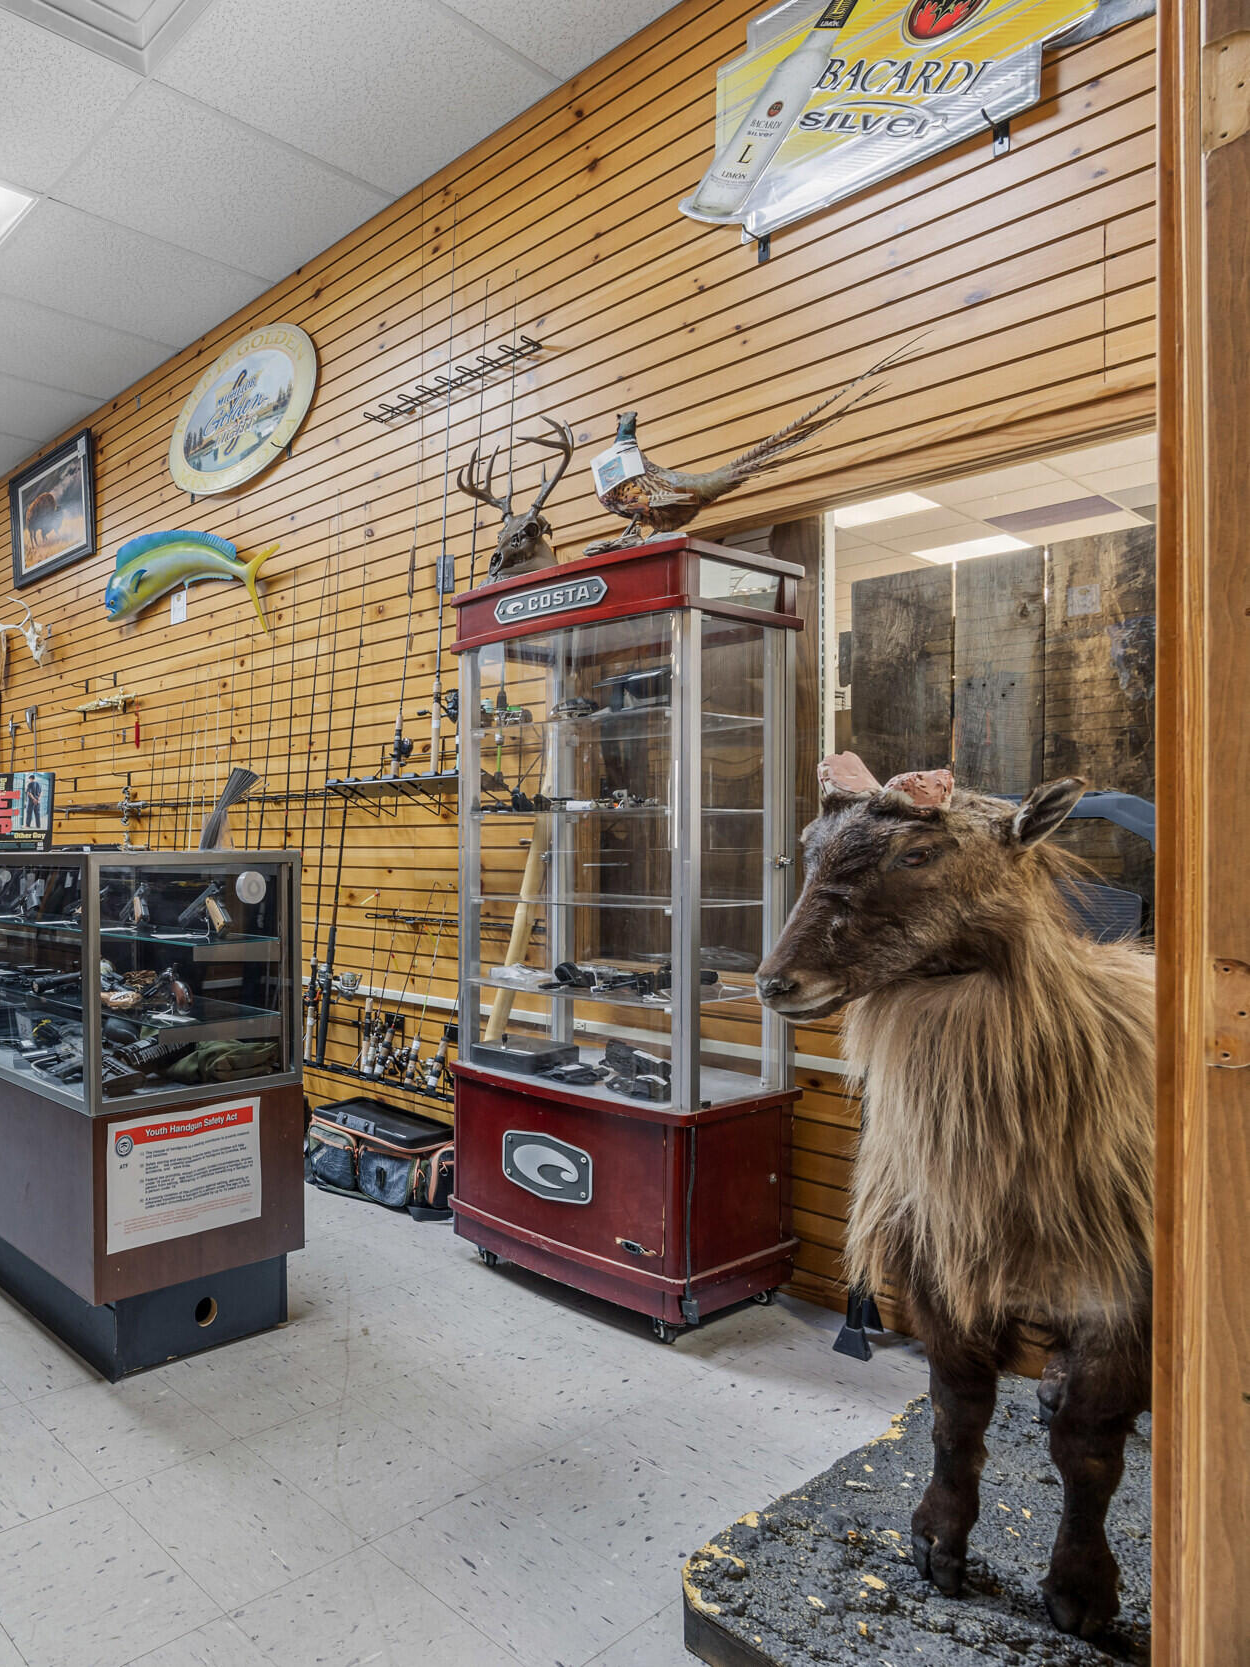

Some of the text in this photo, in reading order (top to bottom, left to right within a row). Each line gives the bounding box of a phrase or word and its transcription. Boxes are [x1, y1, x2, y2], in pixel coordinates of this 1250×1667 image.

[812, 58, 993, 95] BACARDI
[750, 120, 783, 129] BACARDI
[737, 144, 753, 164] L
[528, 585, 590, 611] COSTA
[145, 1113, 238, 1137] Youth Handgun Safety Act
